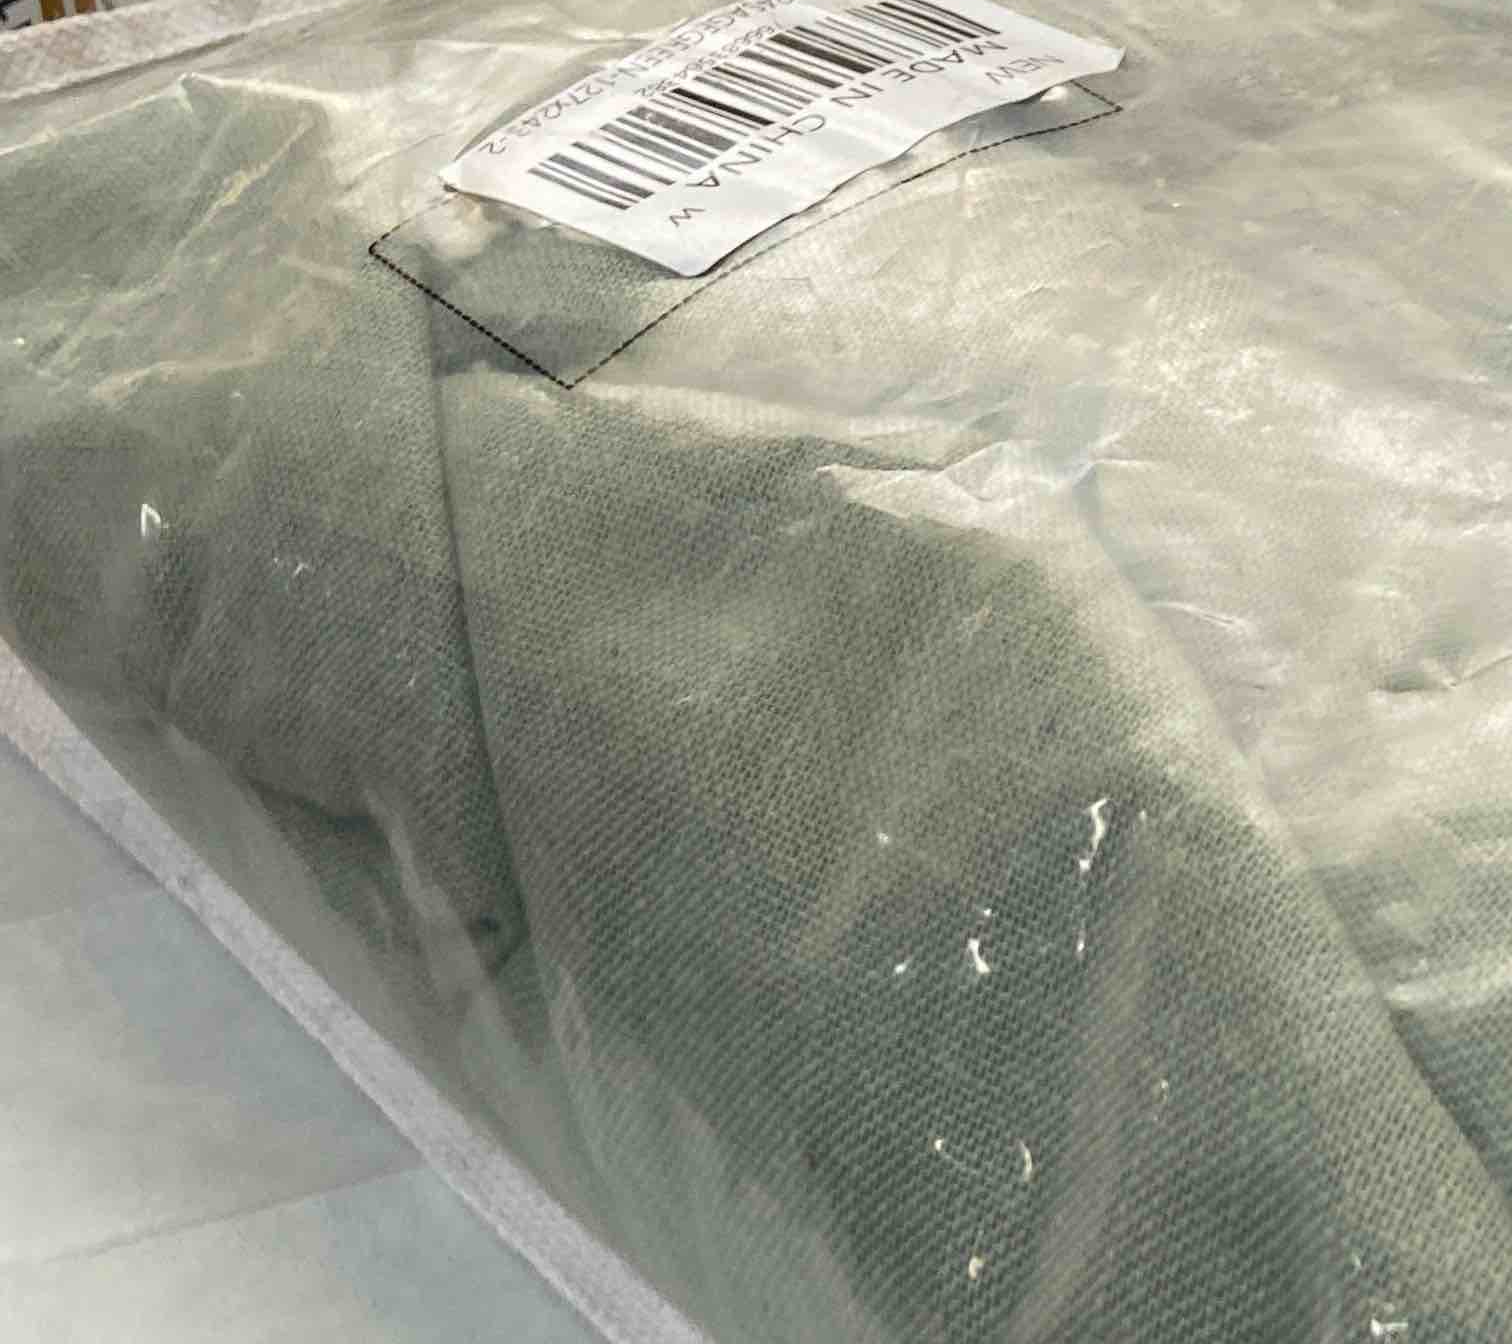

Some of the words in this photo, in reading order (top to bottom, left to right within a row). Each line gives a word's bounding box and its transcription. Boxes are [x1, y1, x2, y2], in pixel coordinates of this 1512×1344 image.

[881, 39, 1009, 84] MADE
[983, 53, 1066, 86] NEW
[830, 80, 885, 110] IN
[695, 114, 827, 188] CHINA
